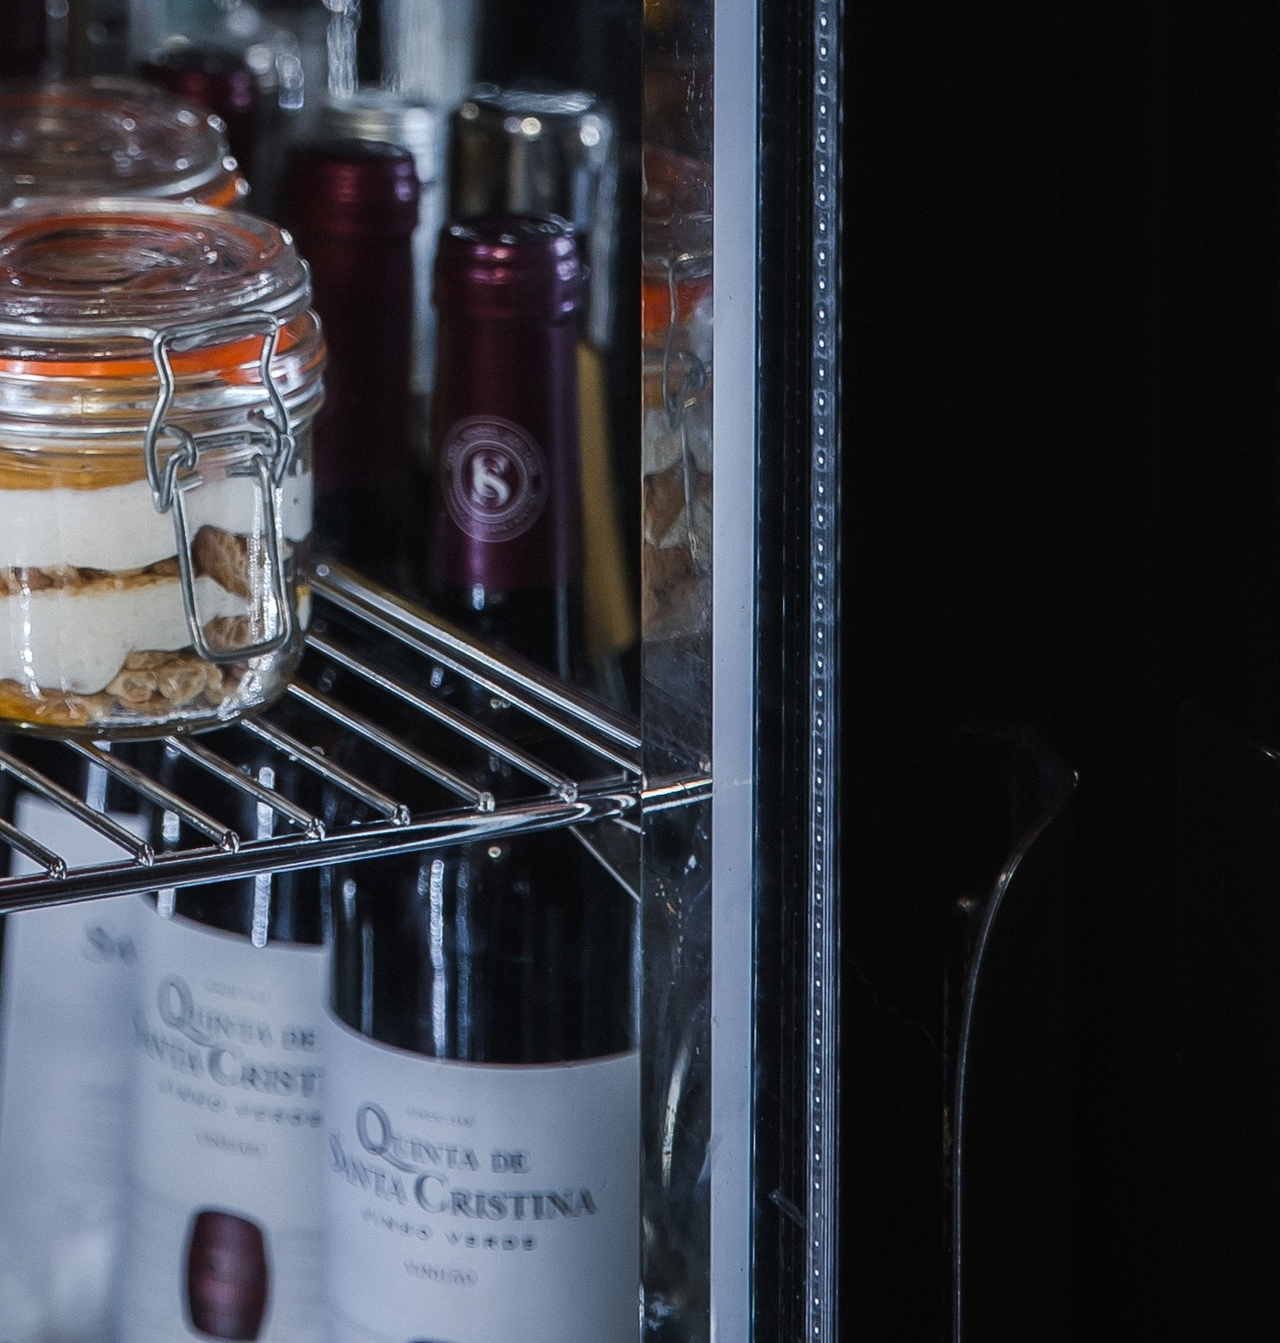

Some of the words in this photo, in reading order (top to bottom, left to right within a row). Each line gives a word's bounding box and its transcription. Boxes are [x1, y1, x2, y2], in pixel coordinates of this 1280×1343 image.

[207, 1045, 320, 1098] CRIST
[356, 1100, 479, 1172] QUINTA
[491, 1150, 531, 1174] DE
[416, 1172, 599, 1221] CRISTINA
